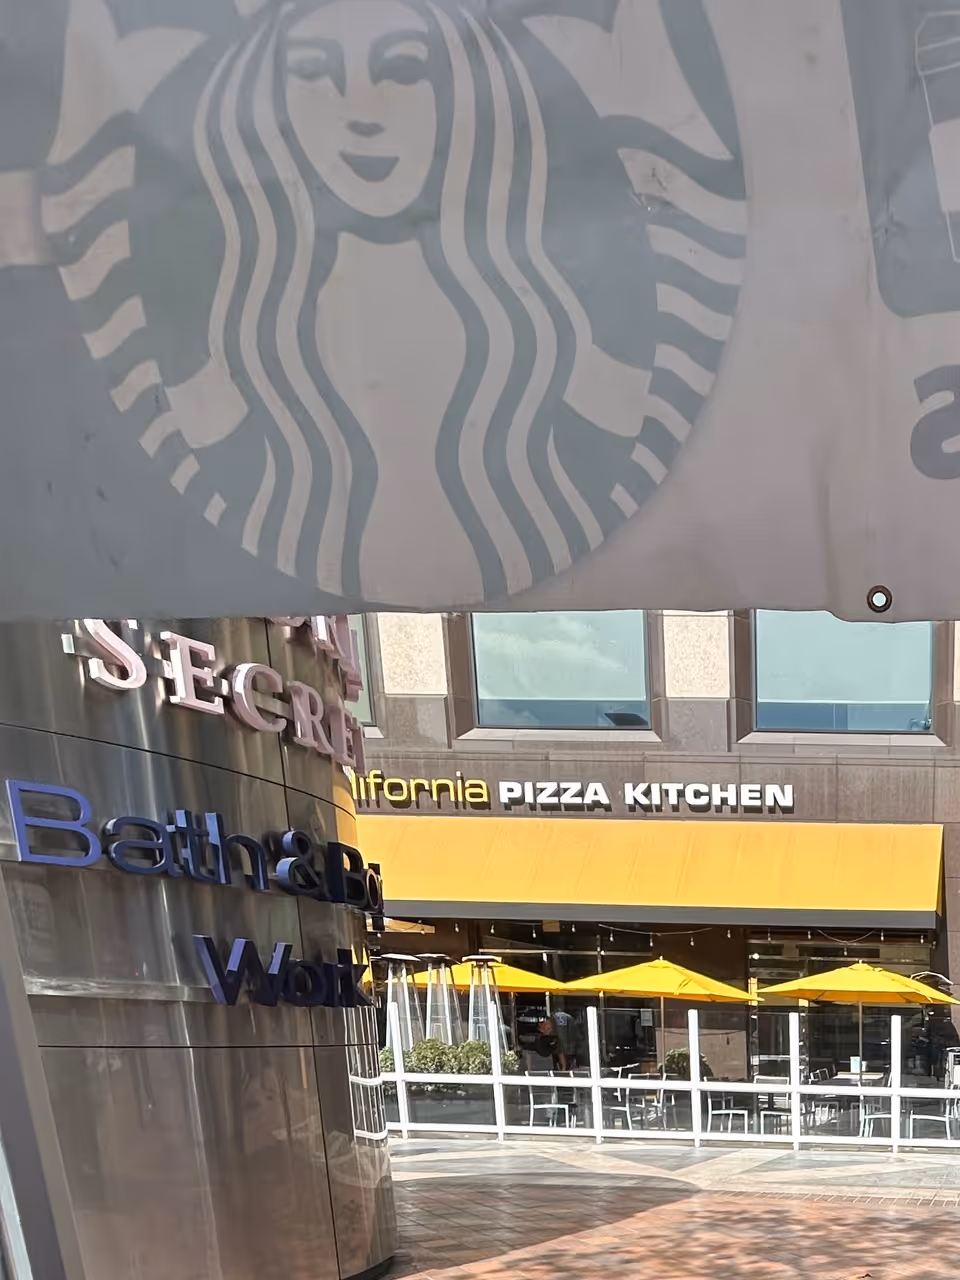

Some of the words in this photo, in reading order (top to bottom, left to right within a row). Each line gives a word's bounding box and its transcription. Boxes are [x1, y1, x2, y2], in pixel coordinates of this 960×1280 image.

[499, 782, 611, 804] PIZZA
[623, 783, 793, 806] KITCHEN
[7, 779, 269, 891] Bath
